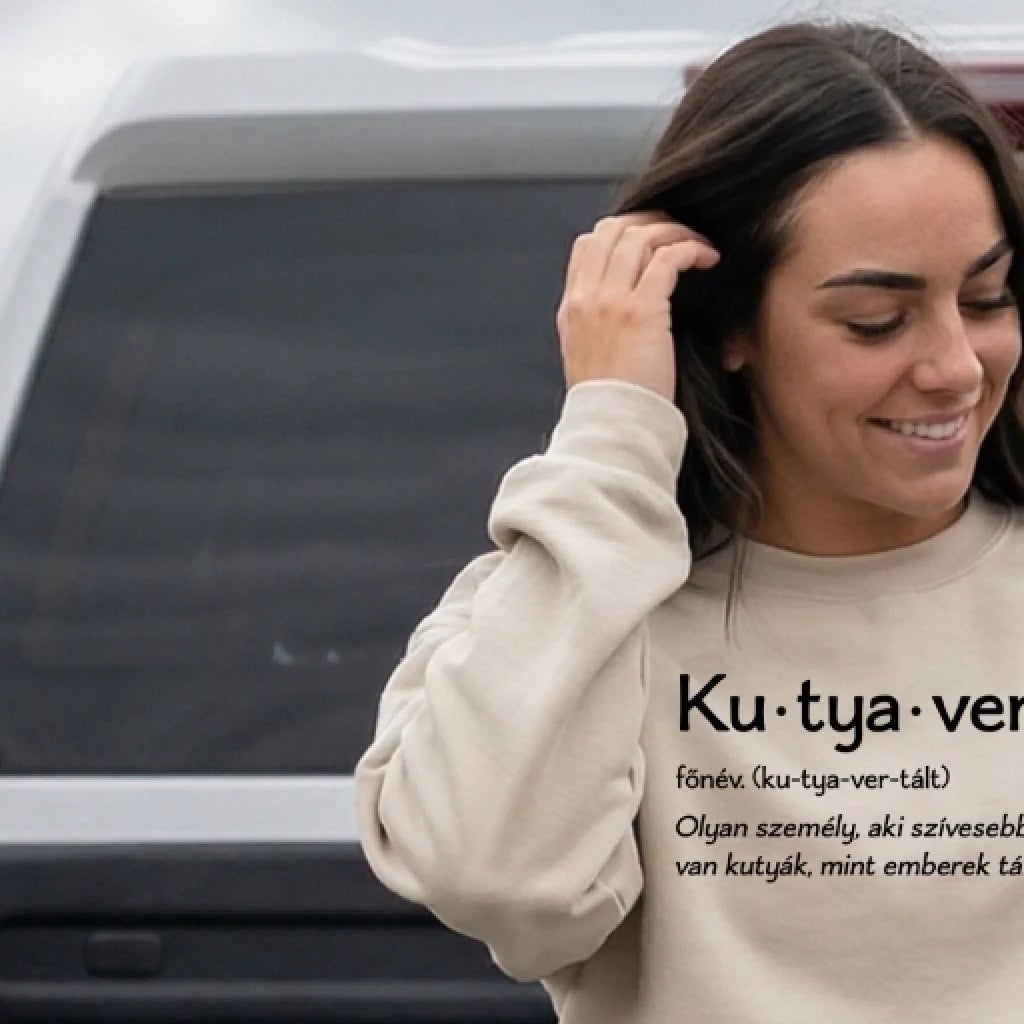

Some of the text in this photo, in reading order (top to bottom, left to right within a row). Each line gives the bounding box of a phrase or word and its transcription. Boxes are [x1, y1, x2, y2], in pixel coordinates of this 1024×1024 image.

[751, 764, 951, 797] (ku-tya-ver-tált)
[675, 813, 748, 845] Olyan
[755, 813, 861, 845] személy,
[867, 813, 904, 837] aki
[675, 861, 717, 875] van
[725, 851, 813, 883] kutyák,
[821, 852, 876, 875] mint
[883, 851, 990, 875] emberek
